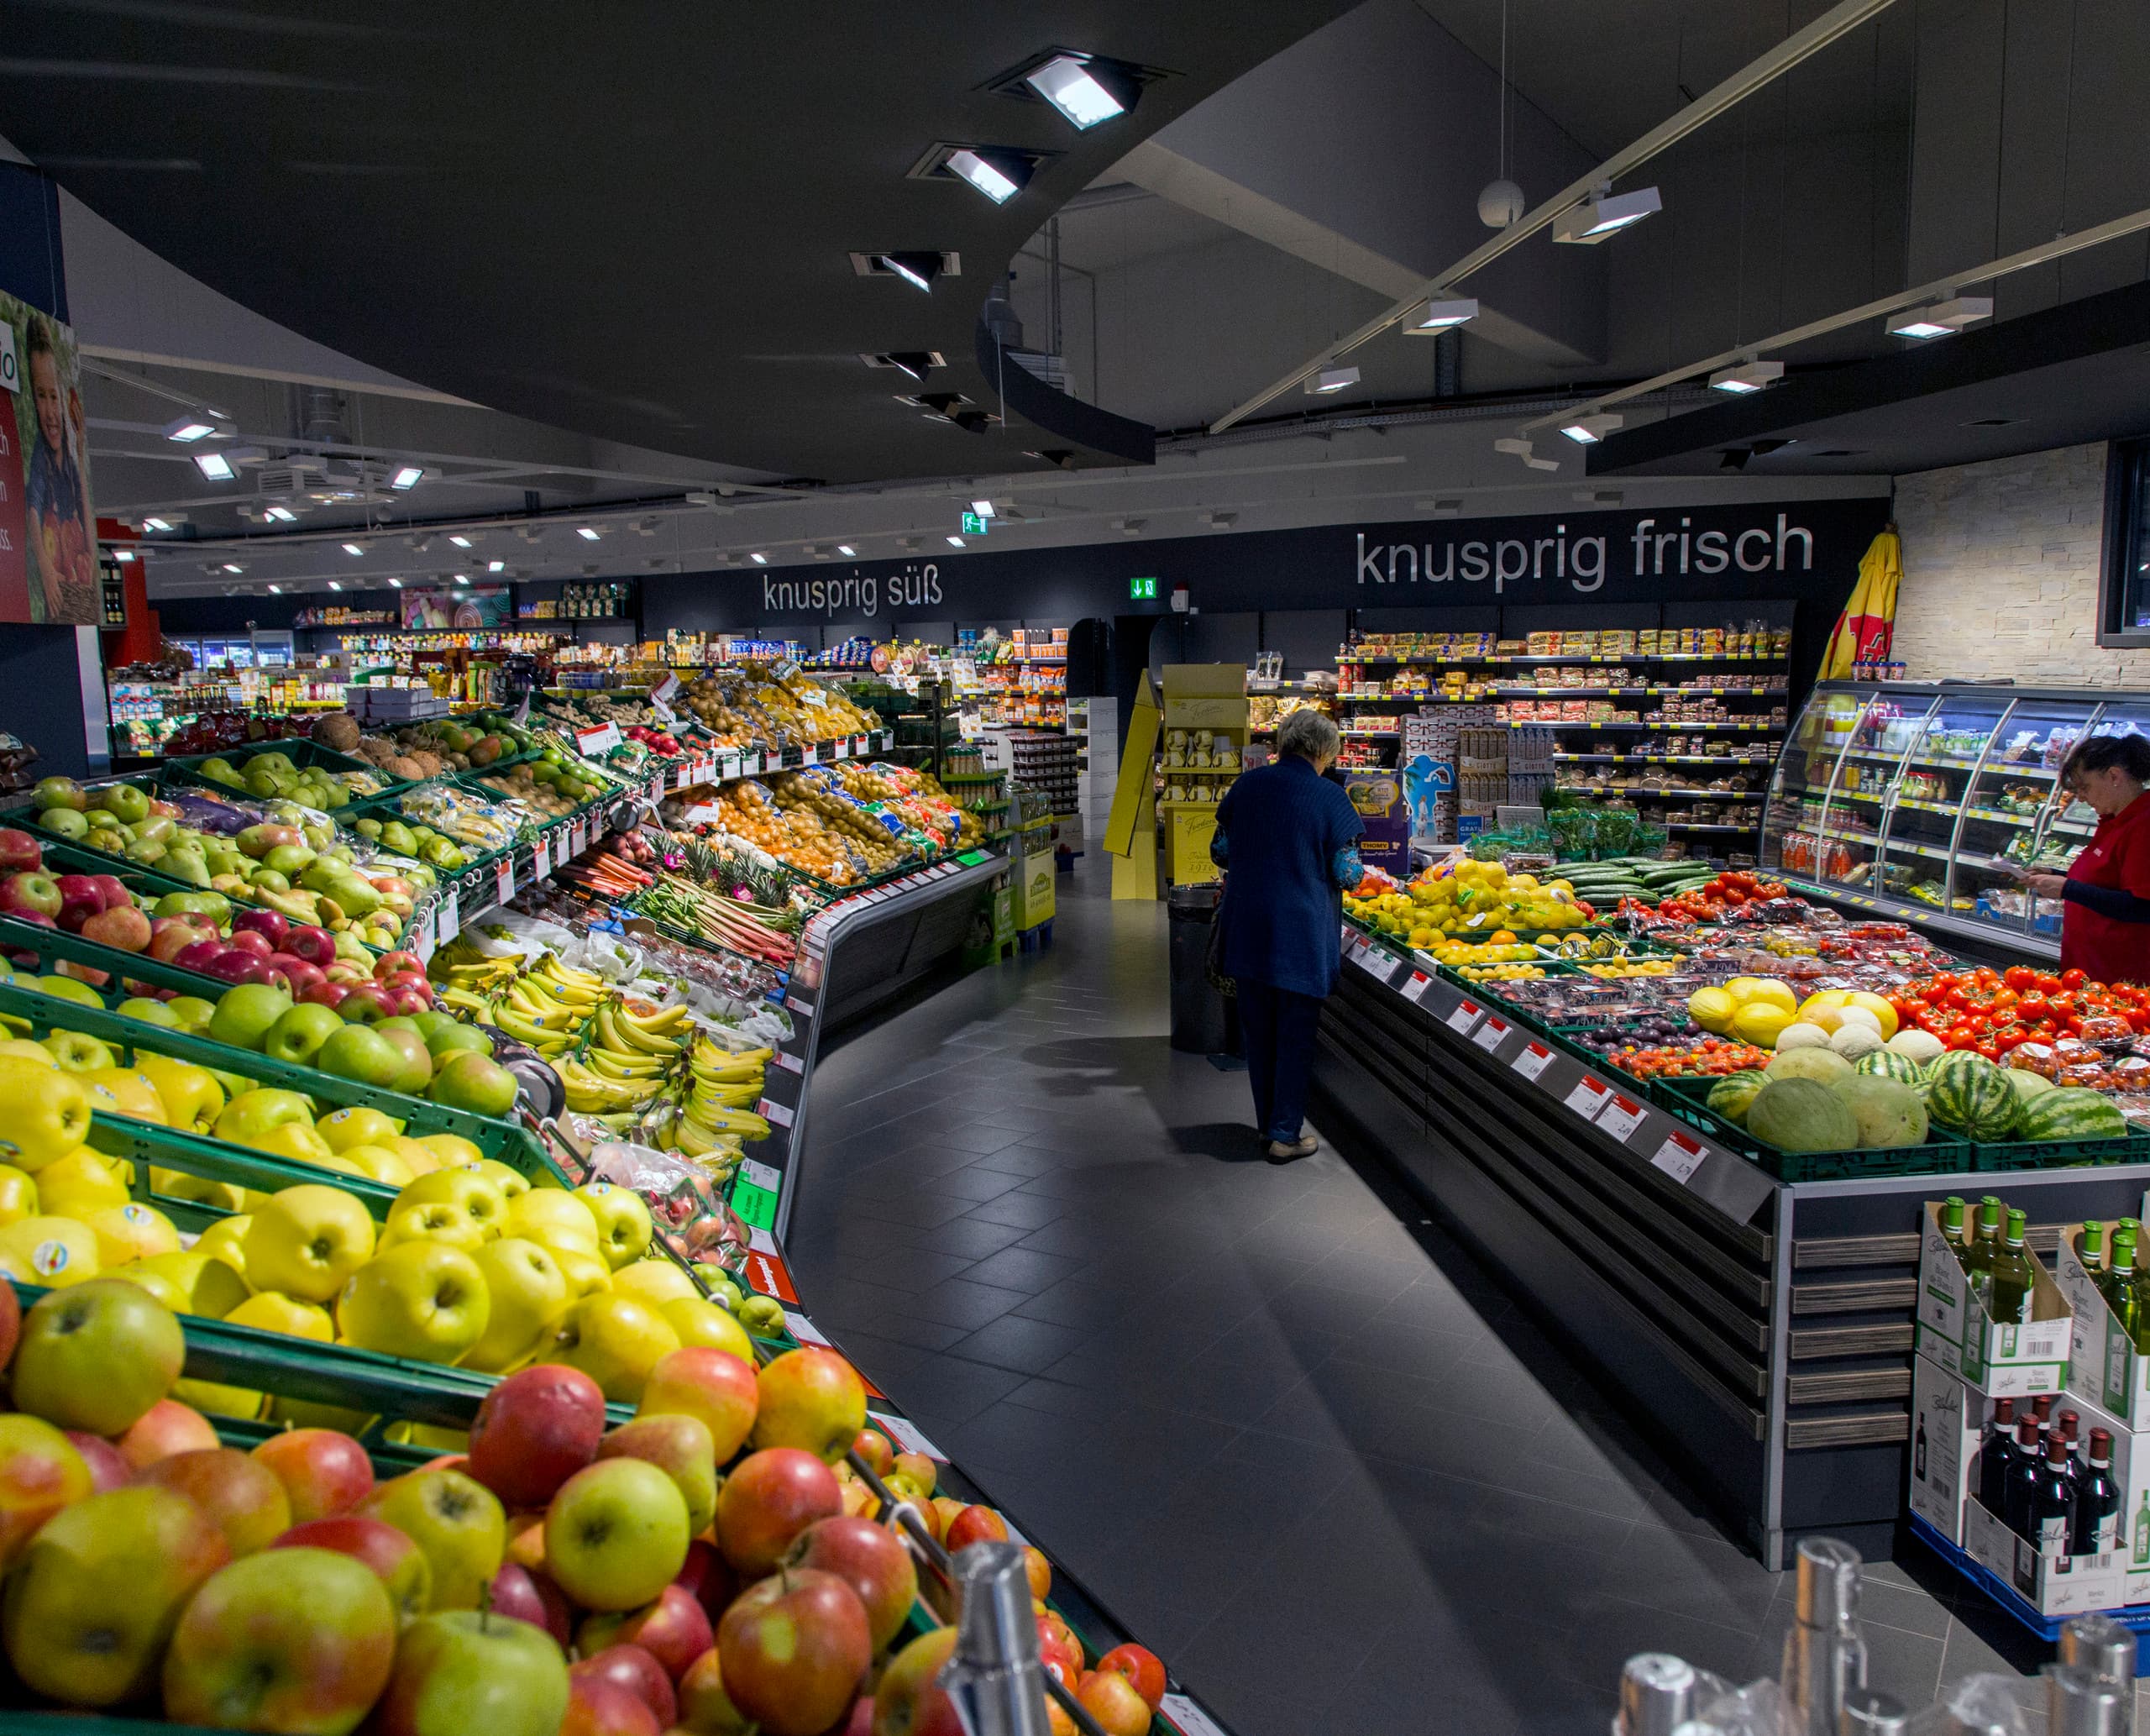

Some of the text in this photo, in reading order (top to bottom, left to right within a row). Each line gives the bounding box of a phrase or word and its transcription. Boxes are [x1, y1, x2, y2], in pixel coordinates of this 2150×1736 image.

[1356, 513, 1812, 593] knusprig frisch
[763, 564, 942, 616] knusprig süß
